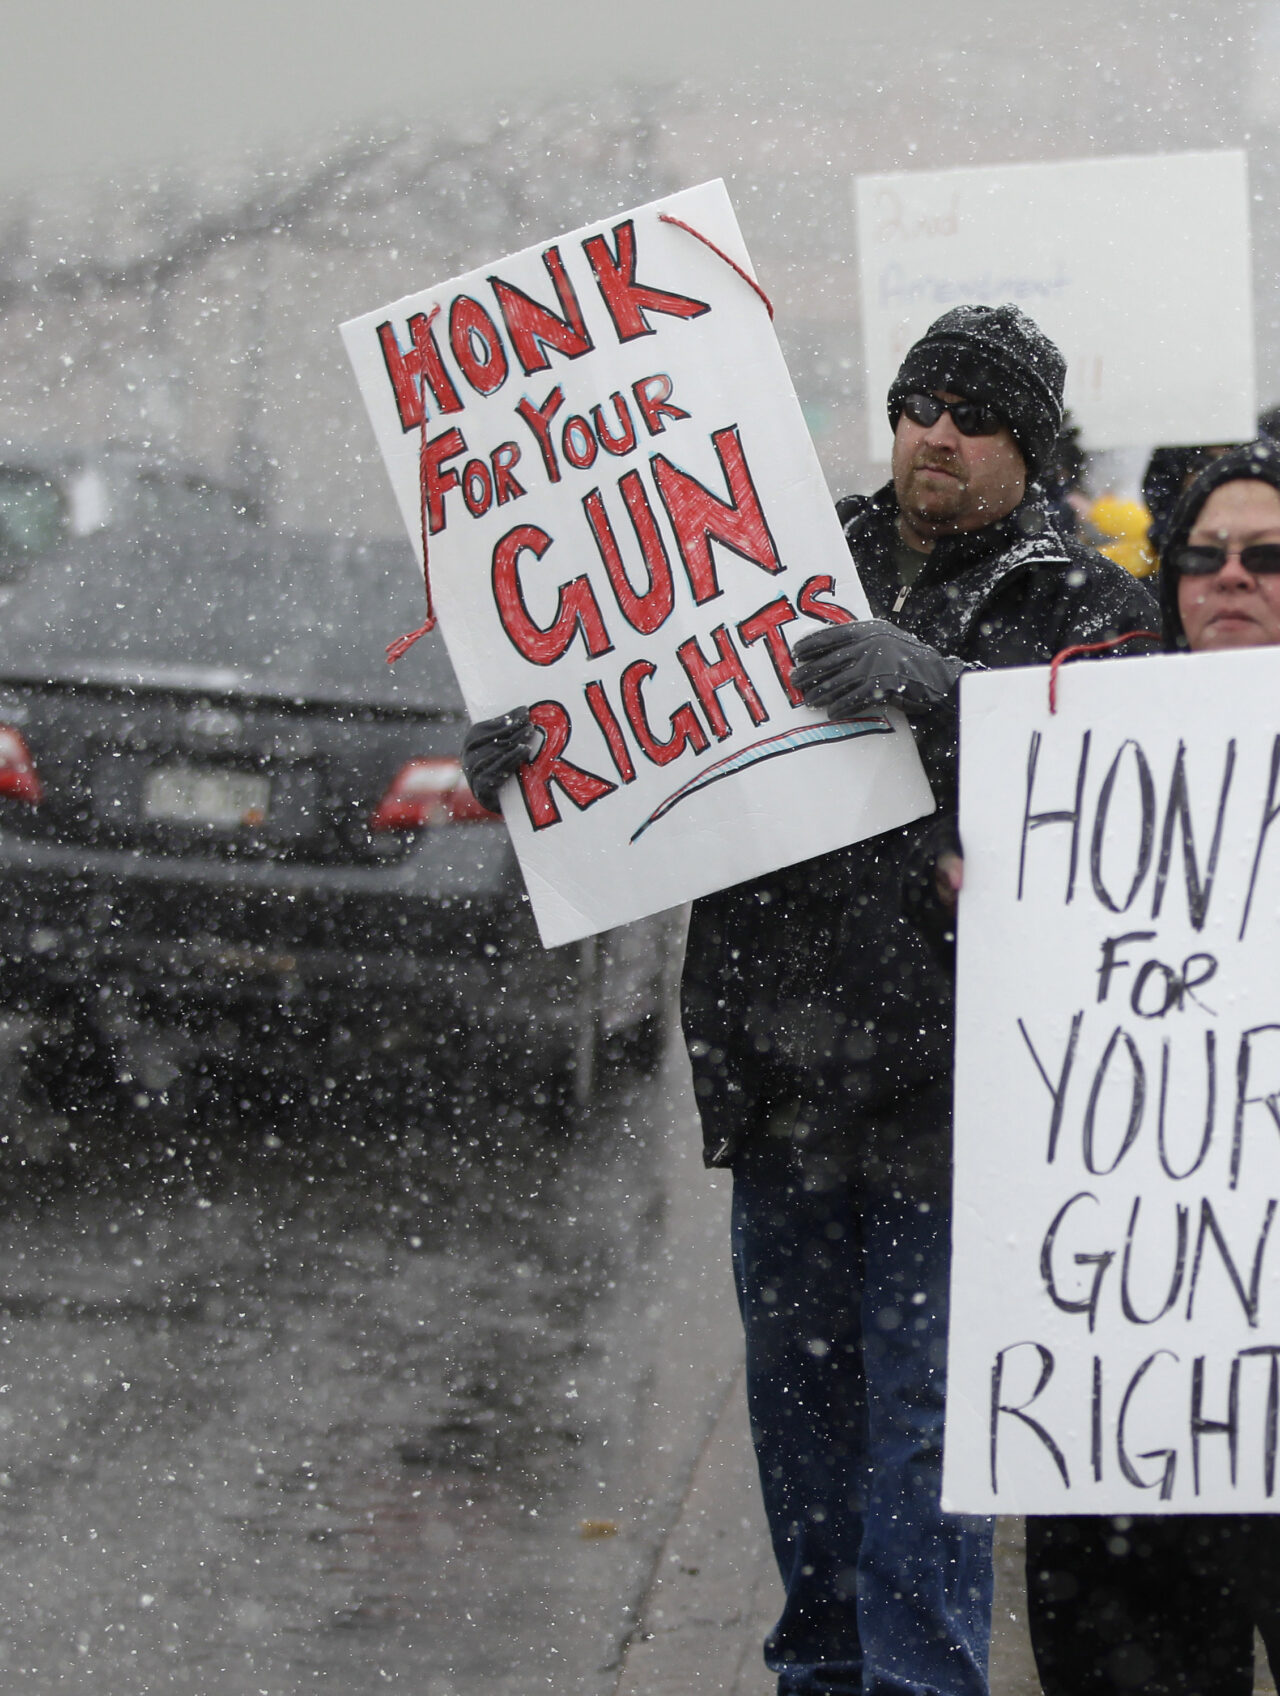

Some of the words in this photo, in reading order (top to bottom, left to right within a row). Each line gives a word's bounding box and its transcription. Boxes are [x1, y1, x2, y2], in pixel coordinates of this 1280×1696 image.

[376, 219, 711, 434] HONK
[422, 425, 528, 536] FOR
[514, 373, 692, 484] YOUR
[491, 424, 787, 667] GUN
[1096, 930, 1220, 1019] FOR
[1038, 1191, 1279, 1333] GUN
